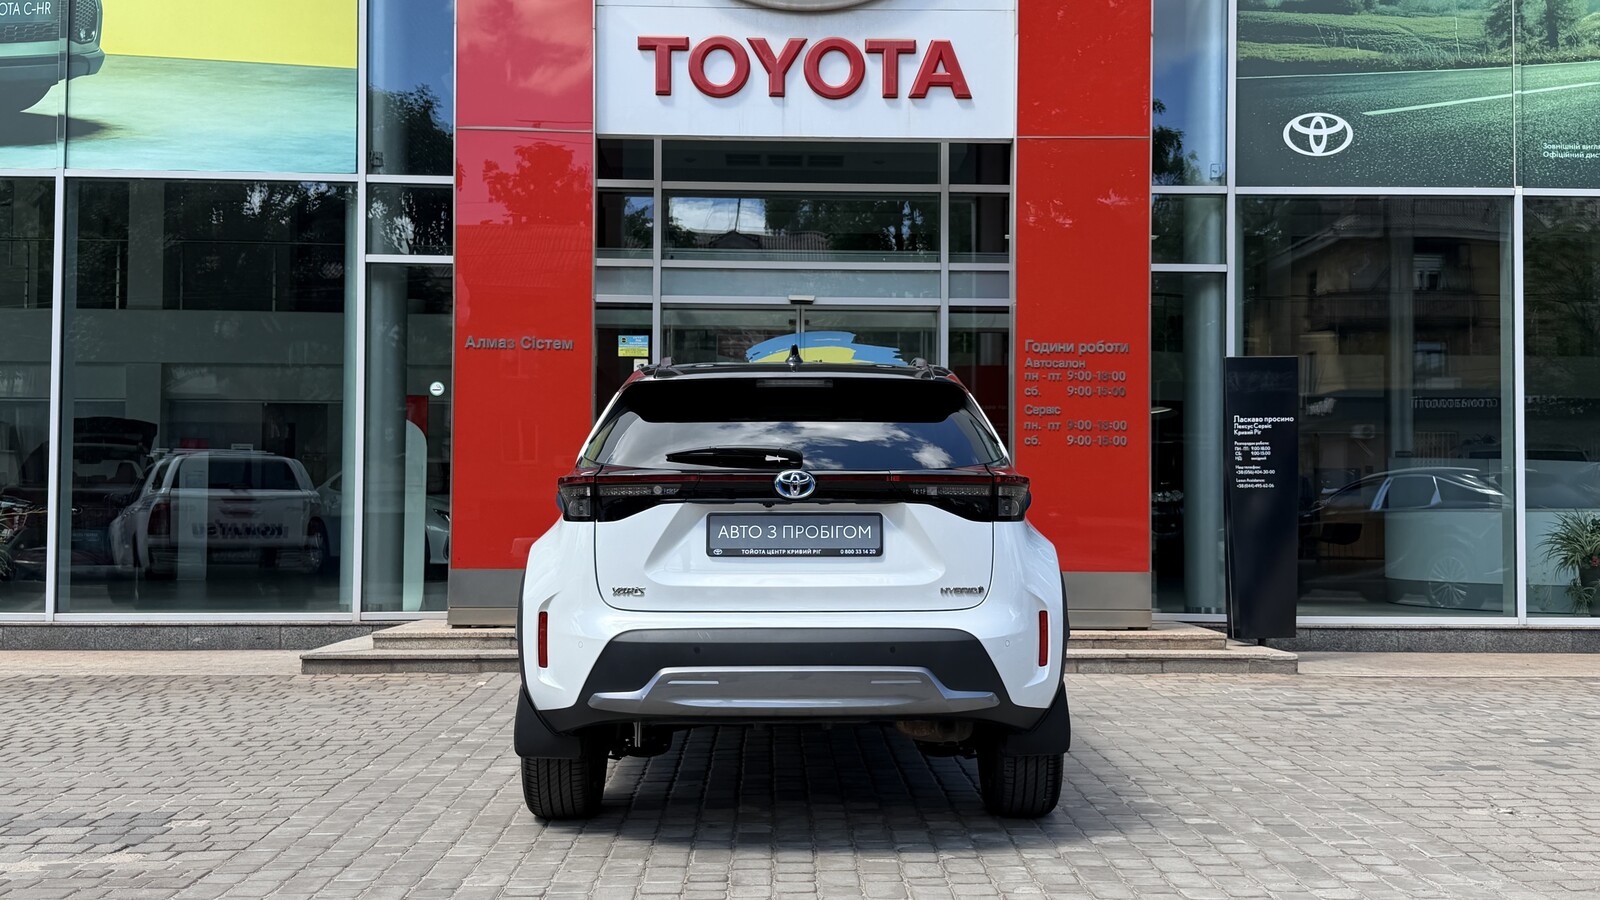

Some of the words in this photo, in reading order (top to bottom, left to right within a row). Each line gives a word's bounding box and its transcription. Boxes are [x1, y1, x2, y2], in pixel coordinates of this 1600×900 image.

[23, 1, 52, 15] C-HR
[637, 36, 973, 99] TOYOTA
[465, 335, 516, 349] Алмаз
[520, 336, 574, 350] Сістем
[1024, 339, 1075, 354] Години
[1078, 340, 1129, 356] роботи
[1024, 358, 1086, 368] Автосалон
[1024, 386, 1041, 396] сб.
[1024, 404, 1061, 416] Сервіс
[1024, 434, 1041, 445] сб.
[717, 525, 763, 539] АВТО
[767, 525, 777, 539] З
[782, 525, 872, 539] ПРОБІГОМ
